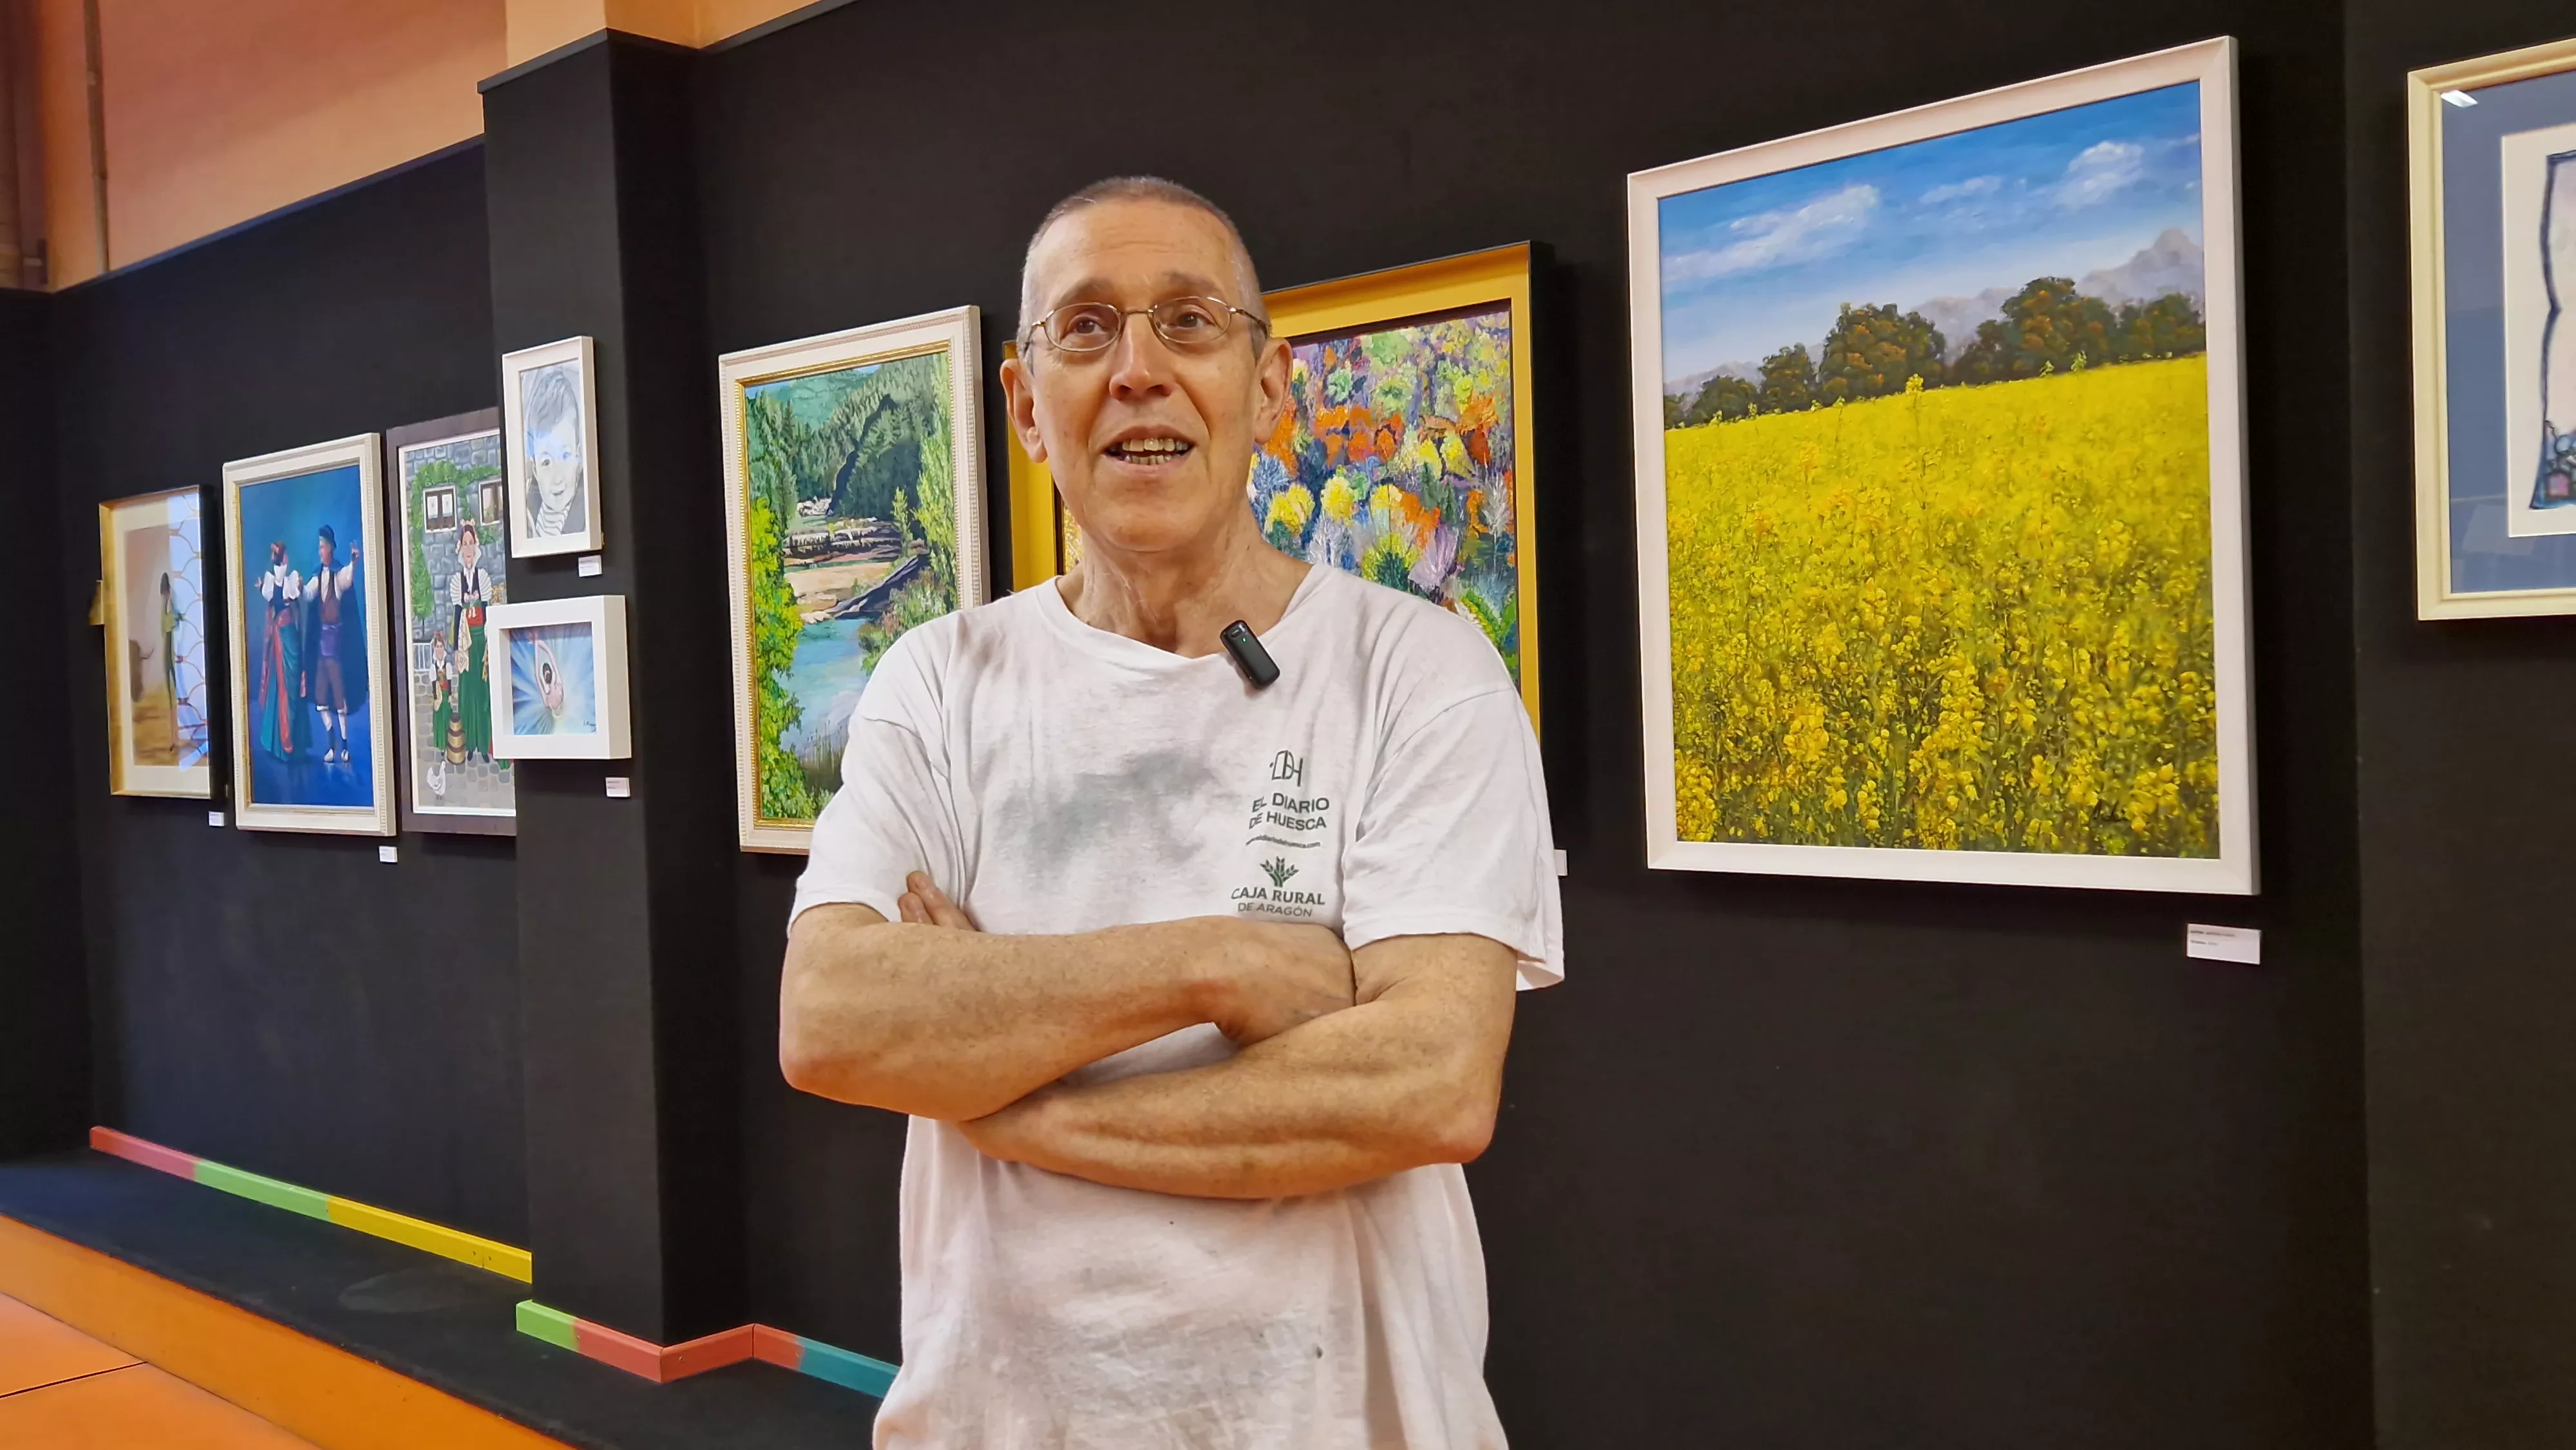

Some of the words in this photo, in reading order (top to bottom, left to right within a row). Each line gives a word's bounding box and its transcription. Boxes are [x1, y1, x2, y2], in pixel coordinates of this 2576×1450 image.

[1252, 796, 1267, 813] EL
[1272, 793, 1329, 813] DIARIO
[1249, 813, 1263, 829] DE
[1266, 811, 1327, 831] HUESCA
[1231, 887, 1267, 899] CAJA
[1272, 889, 1325, 905] RURAL
[1238, 902, 1255, 912] DE
[1256, 903, 1313, 917] ARAGÓN
